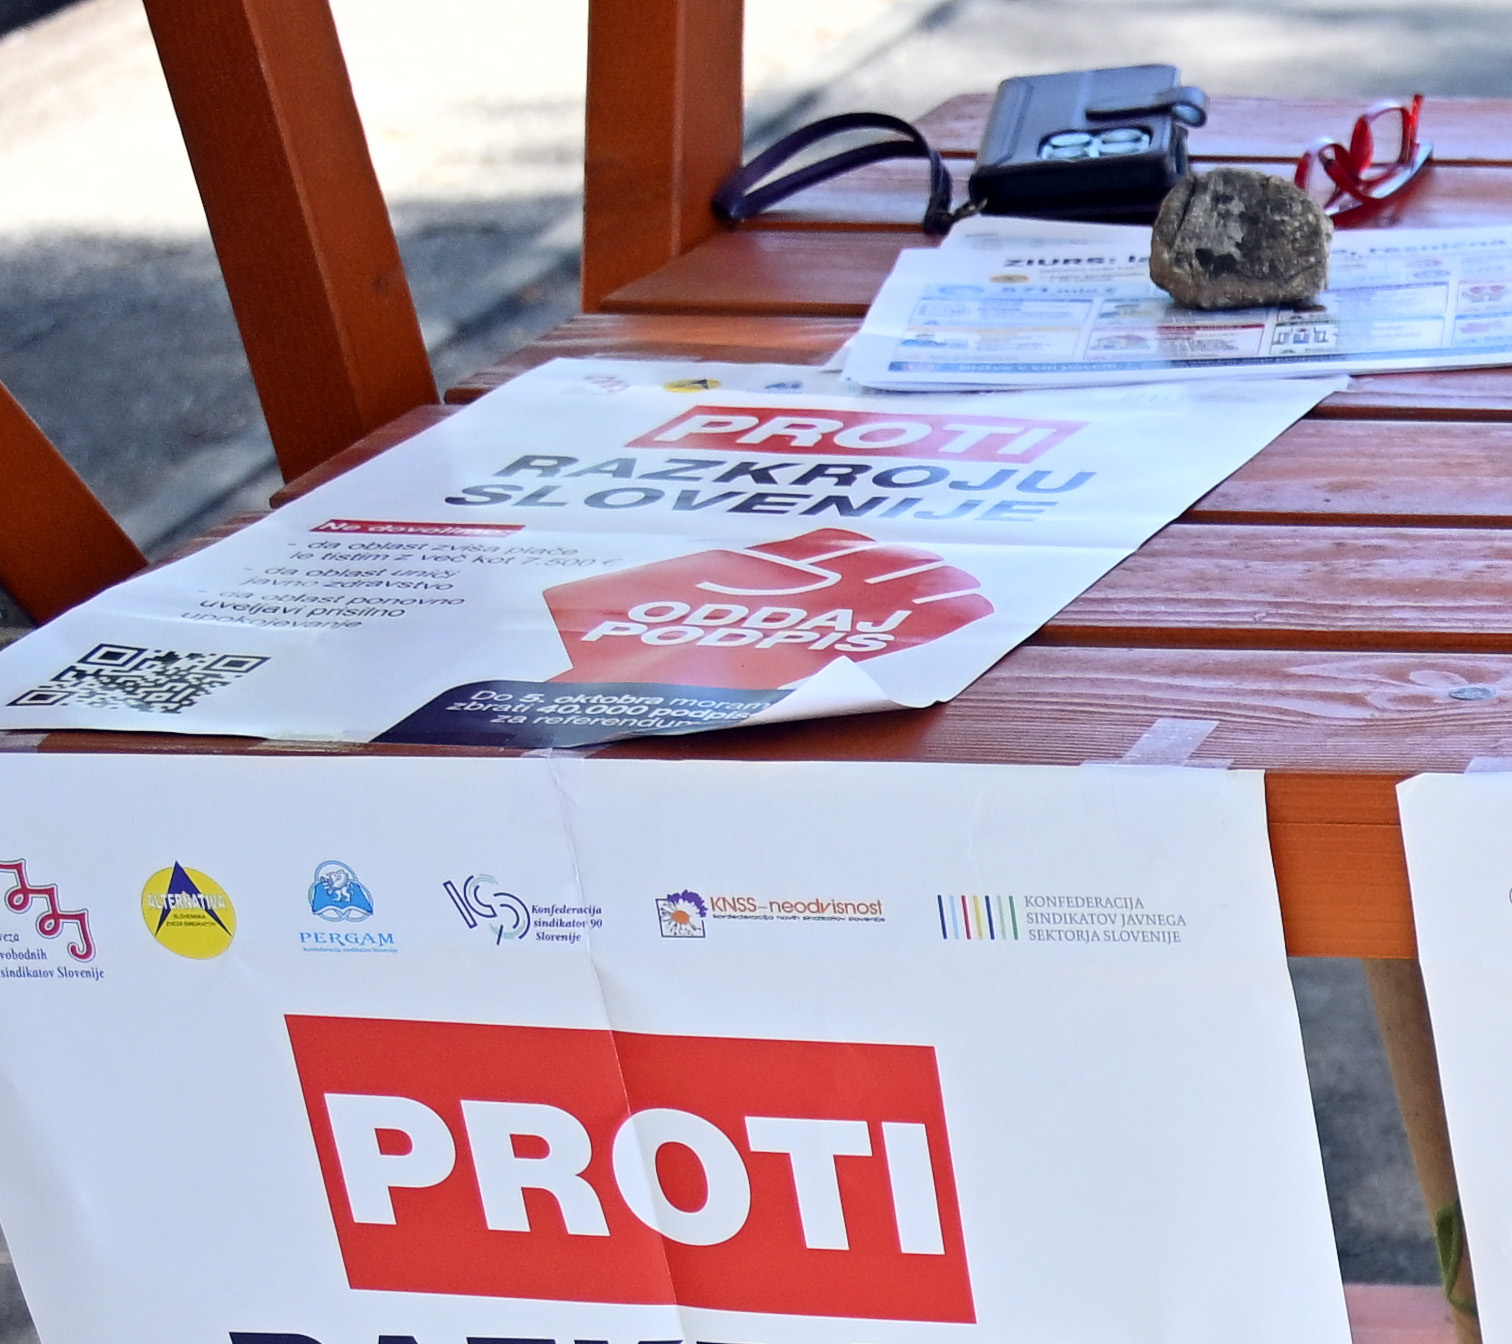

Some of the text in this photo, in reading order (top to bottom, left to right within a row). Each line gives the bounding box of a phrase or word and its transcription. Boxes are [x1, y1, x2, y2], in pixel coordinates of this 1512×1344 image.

[652, 415, 1059, 456] PROTI
[493, 455, 1097, 494] RAZKROJU
[445, 484, 1060, 522] SLOVENIJE
[580, 620, 896, 652] PODPIS
[627, 601, 912, 634] ODDAJ
[324, 1093, 945, 1254] PROTI
